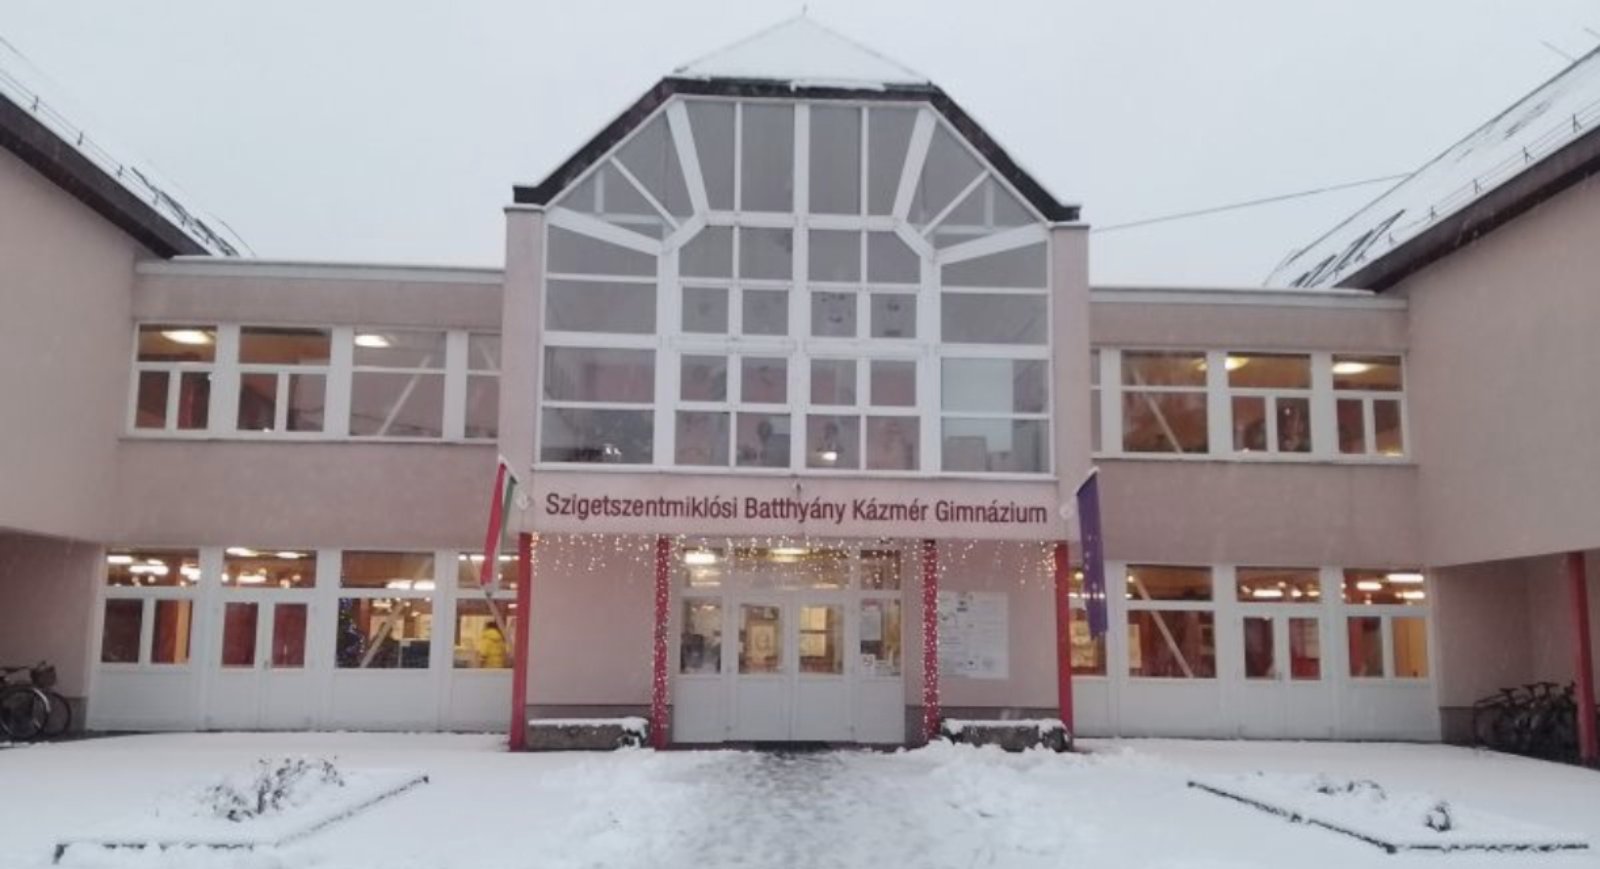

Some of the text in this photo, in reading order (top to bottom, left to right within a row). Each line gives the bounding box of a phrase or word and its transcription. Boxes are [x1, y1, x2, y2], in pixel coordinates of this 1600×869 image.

[545, 492, 1047, 524] Szigetszentmiklósi Batthyány Kázmér Gimnázium
